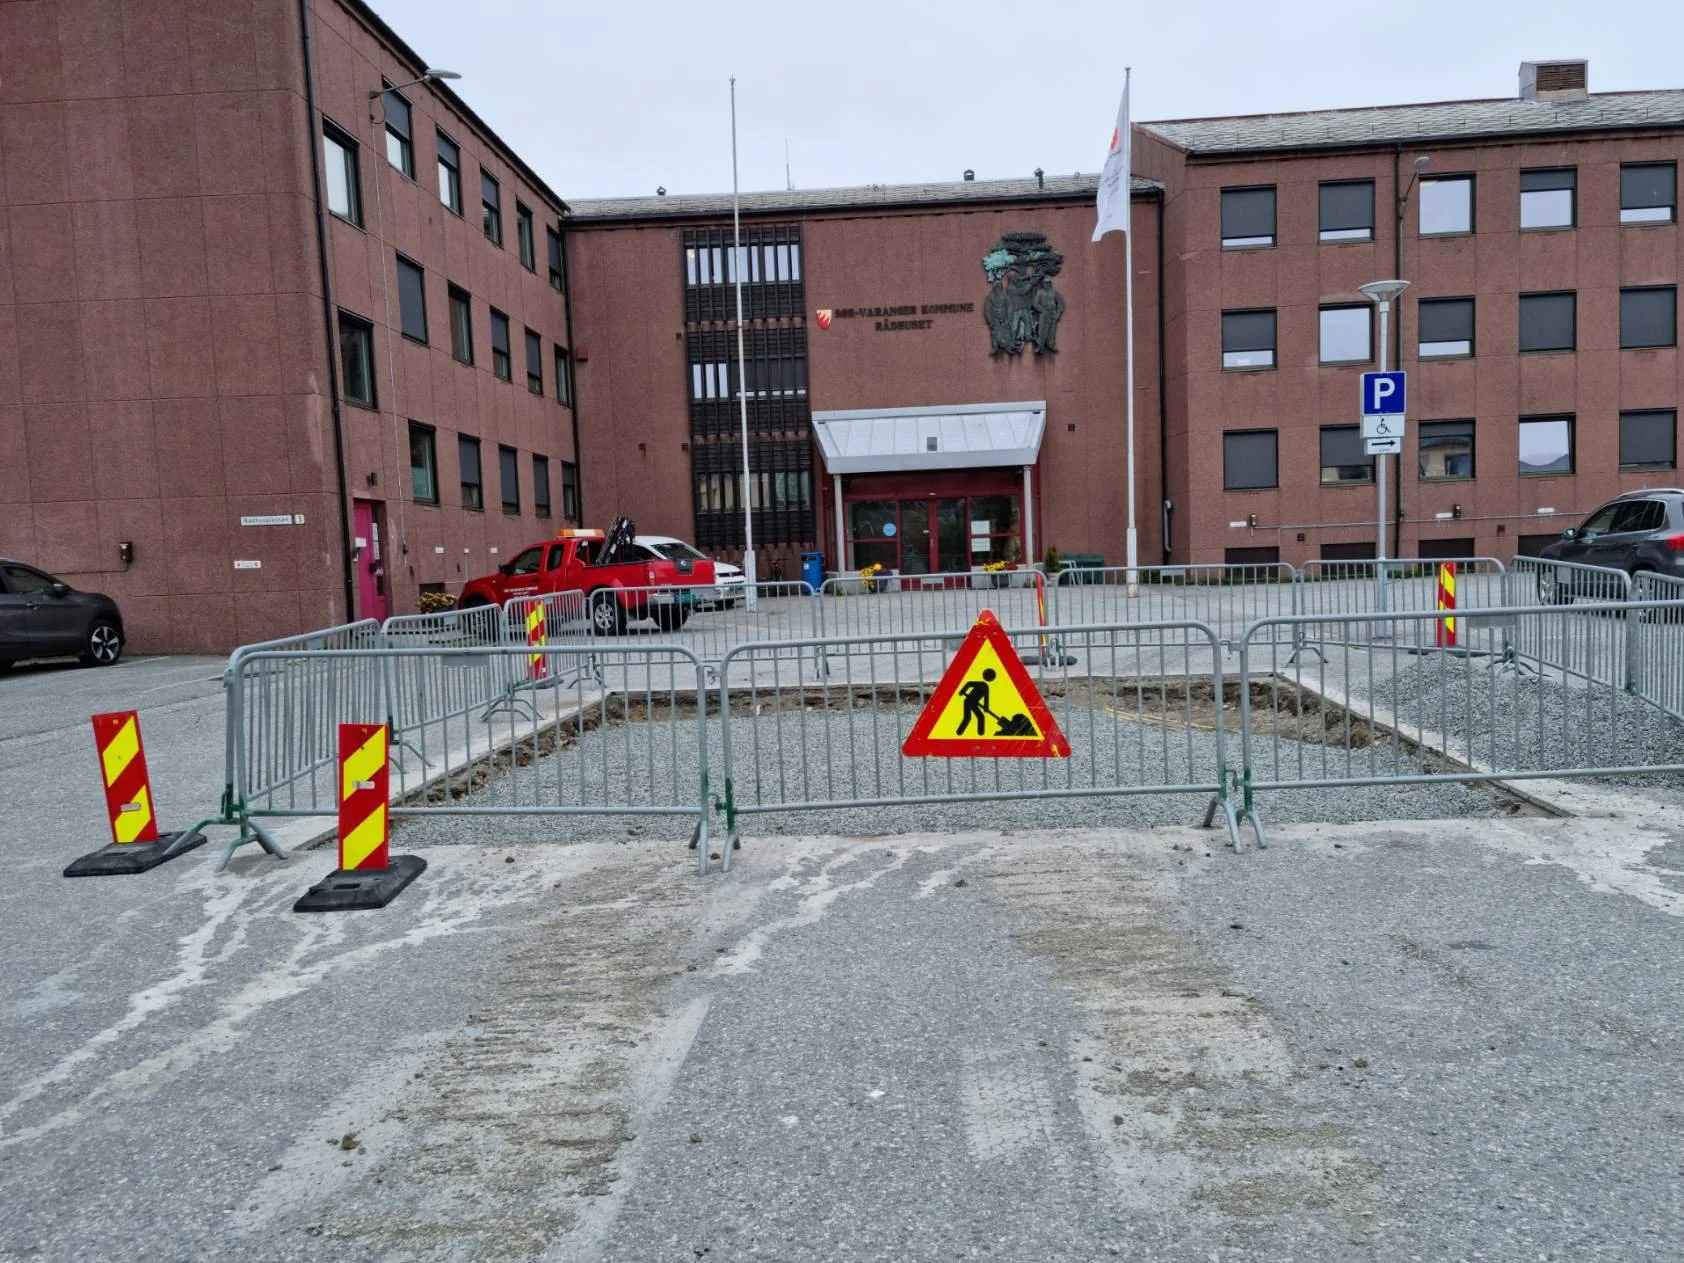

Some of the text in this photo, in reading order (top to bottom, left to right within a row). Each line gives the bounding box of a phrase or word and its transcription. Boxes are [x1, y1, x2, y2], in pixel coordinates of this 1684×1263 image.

[921, 302, 974, 315] KOMMUNE
[875, 319, 933, 332] RÅDHUSET
[1374, 378, 1395, 410] P
